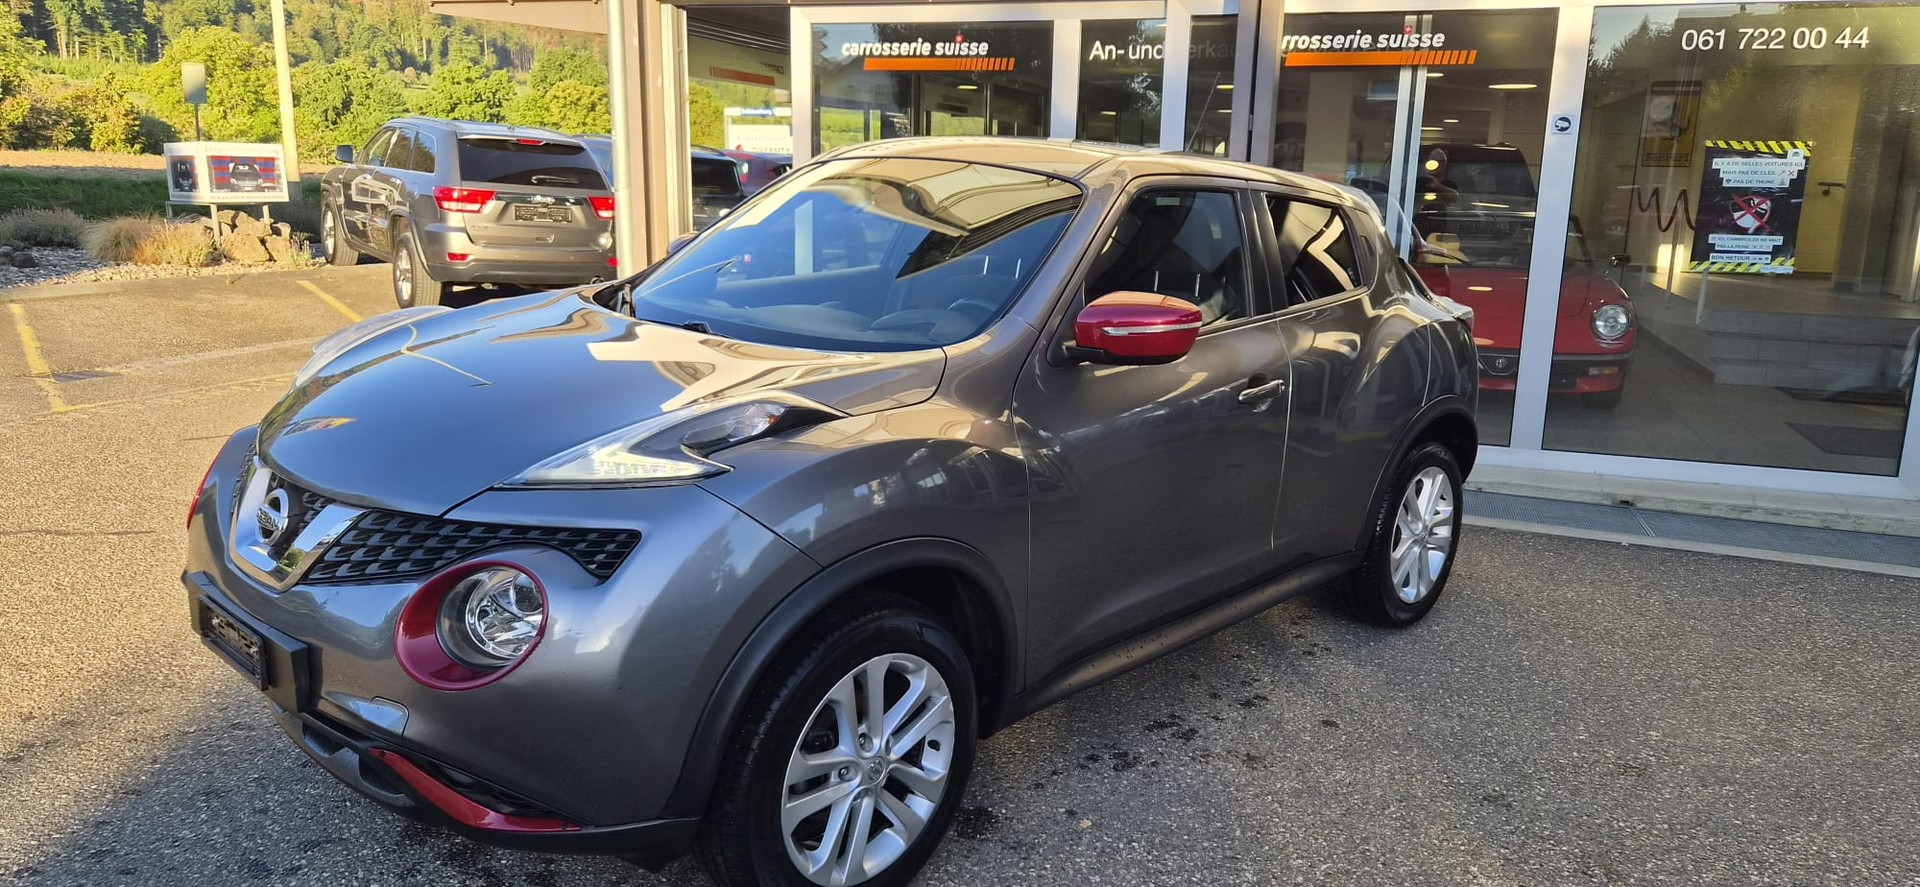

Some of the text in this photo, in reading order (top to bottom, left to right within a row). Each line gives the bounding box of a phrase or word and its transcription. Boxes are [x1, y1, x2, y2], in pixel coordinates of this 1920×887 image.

[841, 35, 989, 56] carrosserie suisse
[1281, 25, 1446, 50] rrosserie suisse
[1681, 26, 1870, 51] 061 722 00 44
[1089, 40, 1125, 61] An-
